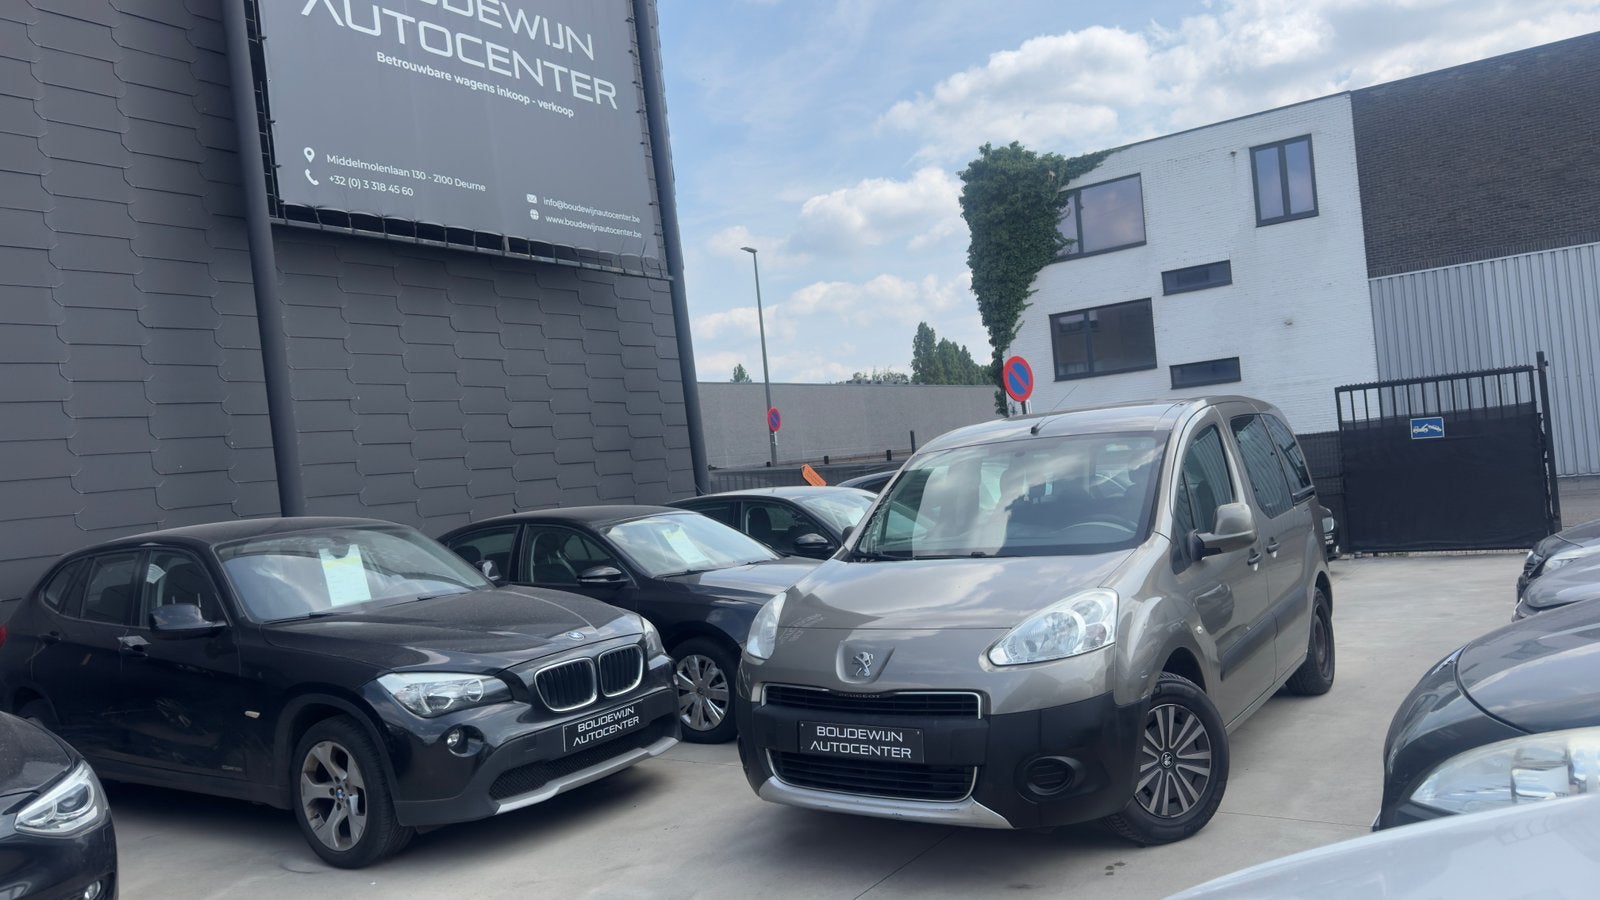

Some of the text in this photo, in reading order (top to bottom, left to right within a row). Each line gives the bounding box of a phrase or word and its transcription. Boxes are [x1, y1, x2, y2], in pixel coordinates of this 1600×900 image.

[416, 0, 595, 61] EWIJN
[301, 0, 617, 110] AUTOCENTER
[376, 51, 452, 81] Betrouwbare
[453, 74, 495, 94] wagens
[496, 85, 530, 105] inkoop
[537, 98, 575, 118] verkoop
[326, 154, 410, 178] Middelmolenlaan
[410, 169, 426, 181] 130
[433, 173, 453, 186] 2100
[454, 178, 486, 192] Deurne
[329, 174, 414, 197] +32 (0) 3 318 45 60
[543, 197, 641, 224] info@boudewijnautocenter.be
[545, 215, 642, 239] www.boudewijnautocenter.be
[572, 715, 640, 747] AUTOCENTER
[577, 705, 635, 733] BOUDEWIJN
[816, 725, 903, 743] BOUDEWIJN
[810, 740, 912, 759] AUTOCENTER
